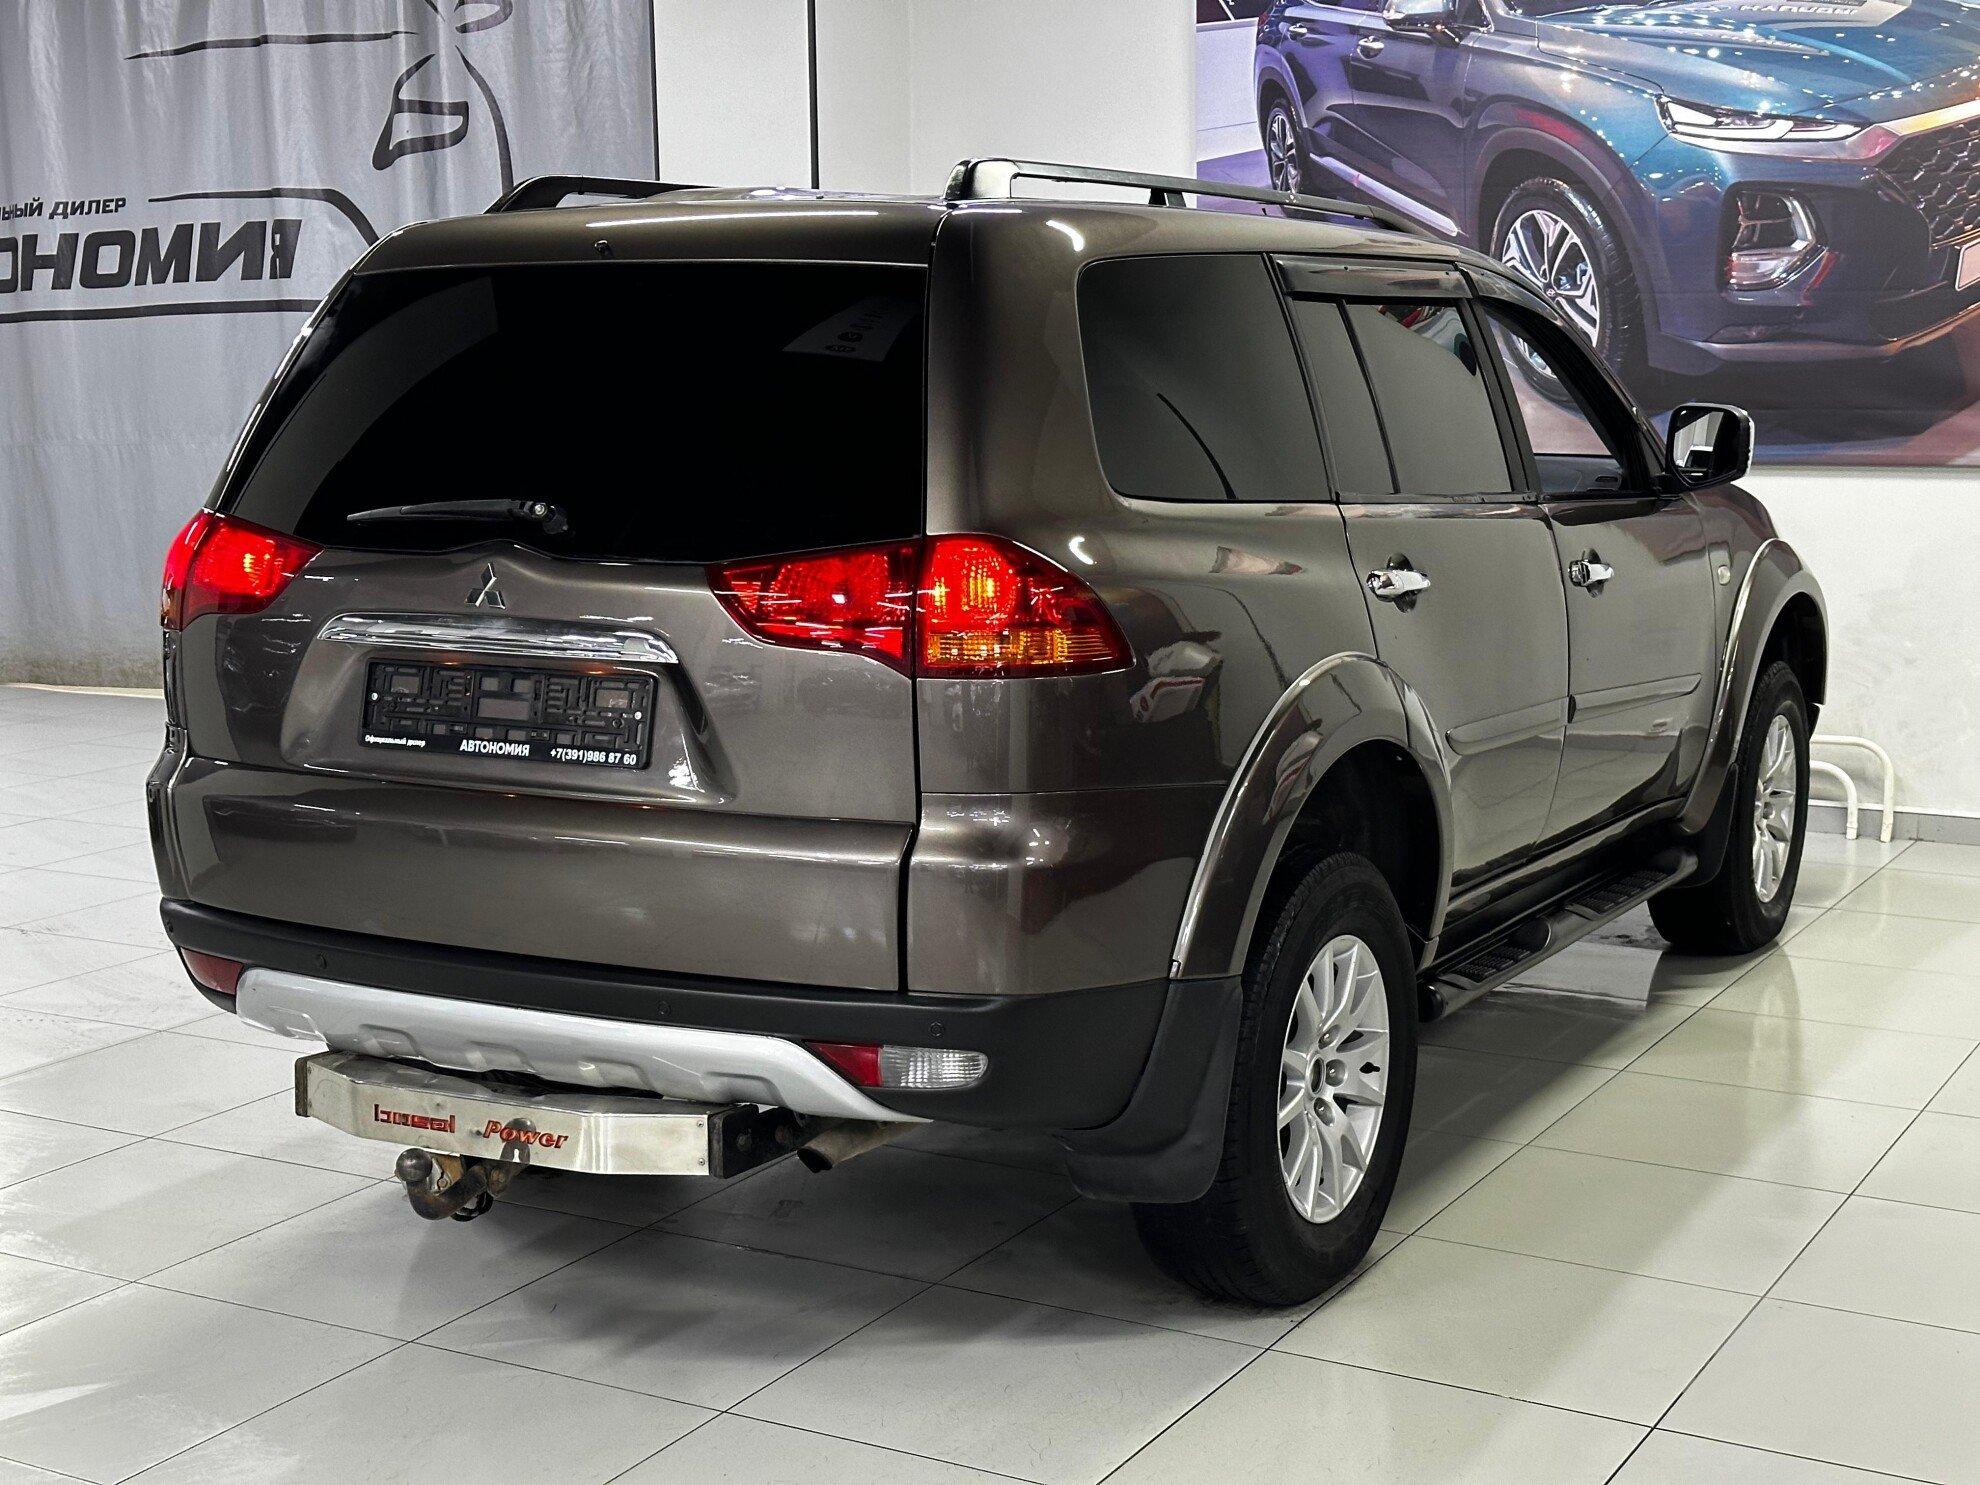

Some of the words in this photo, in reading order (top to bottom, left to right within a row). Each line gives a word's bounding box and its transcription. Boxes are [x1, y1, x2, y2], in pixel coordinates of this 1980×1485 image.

[0, 197, 42, 221] ЬНЫЙ
[49, 198, 126, 219] ДИЛЕР
[460, 739, 530, 757] АВТОНОМИЯ
[550, 747, 606, 764] +7(391)986
[608, 752, 621, 764] 87
[623, 753, 637, 766] 60
[483, 1119, 569, 1149] Power
